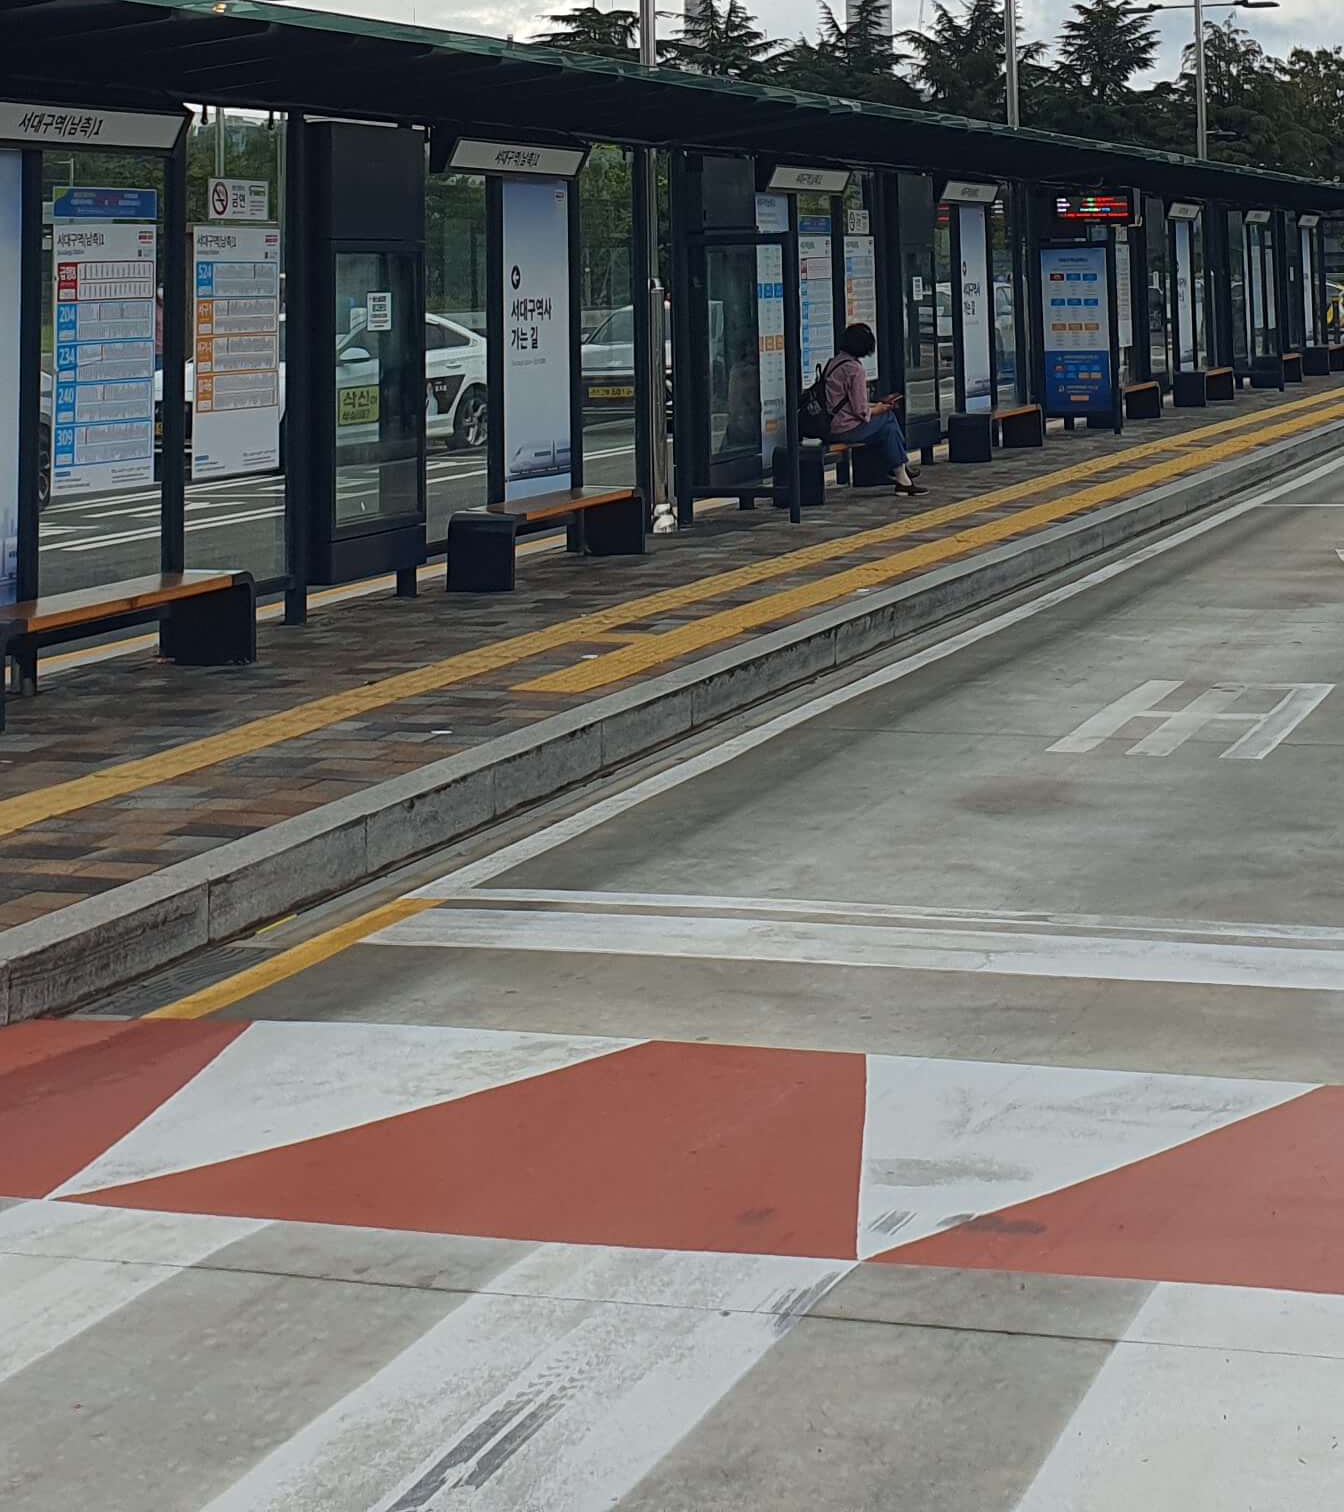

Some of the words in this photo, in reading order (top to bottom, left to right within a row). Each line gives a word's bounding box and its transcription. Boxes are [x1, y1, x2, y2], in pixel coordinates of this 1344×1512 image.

[18, 112, 104, 138] 서대구역(남측)1
[57, 231, 105, 248] 서대구역(남측)1
[59, 306, 75, 323] 204
[511, 297, 552, 321] 서대구역사
[511, 327, 528, 350] 가는
[531, 326, 539, 349] 길
[59, 348, 75, 364] 234
[58, 389, 74, 405] 240
[57, 430, 73, 446] 309
